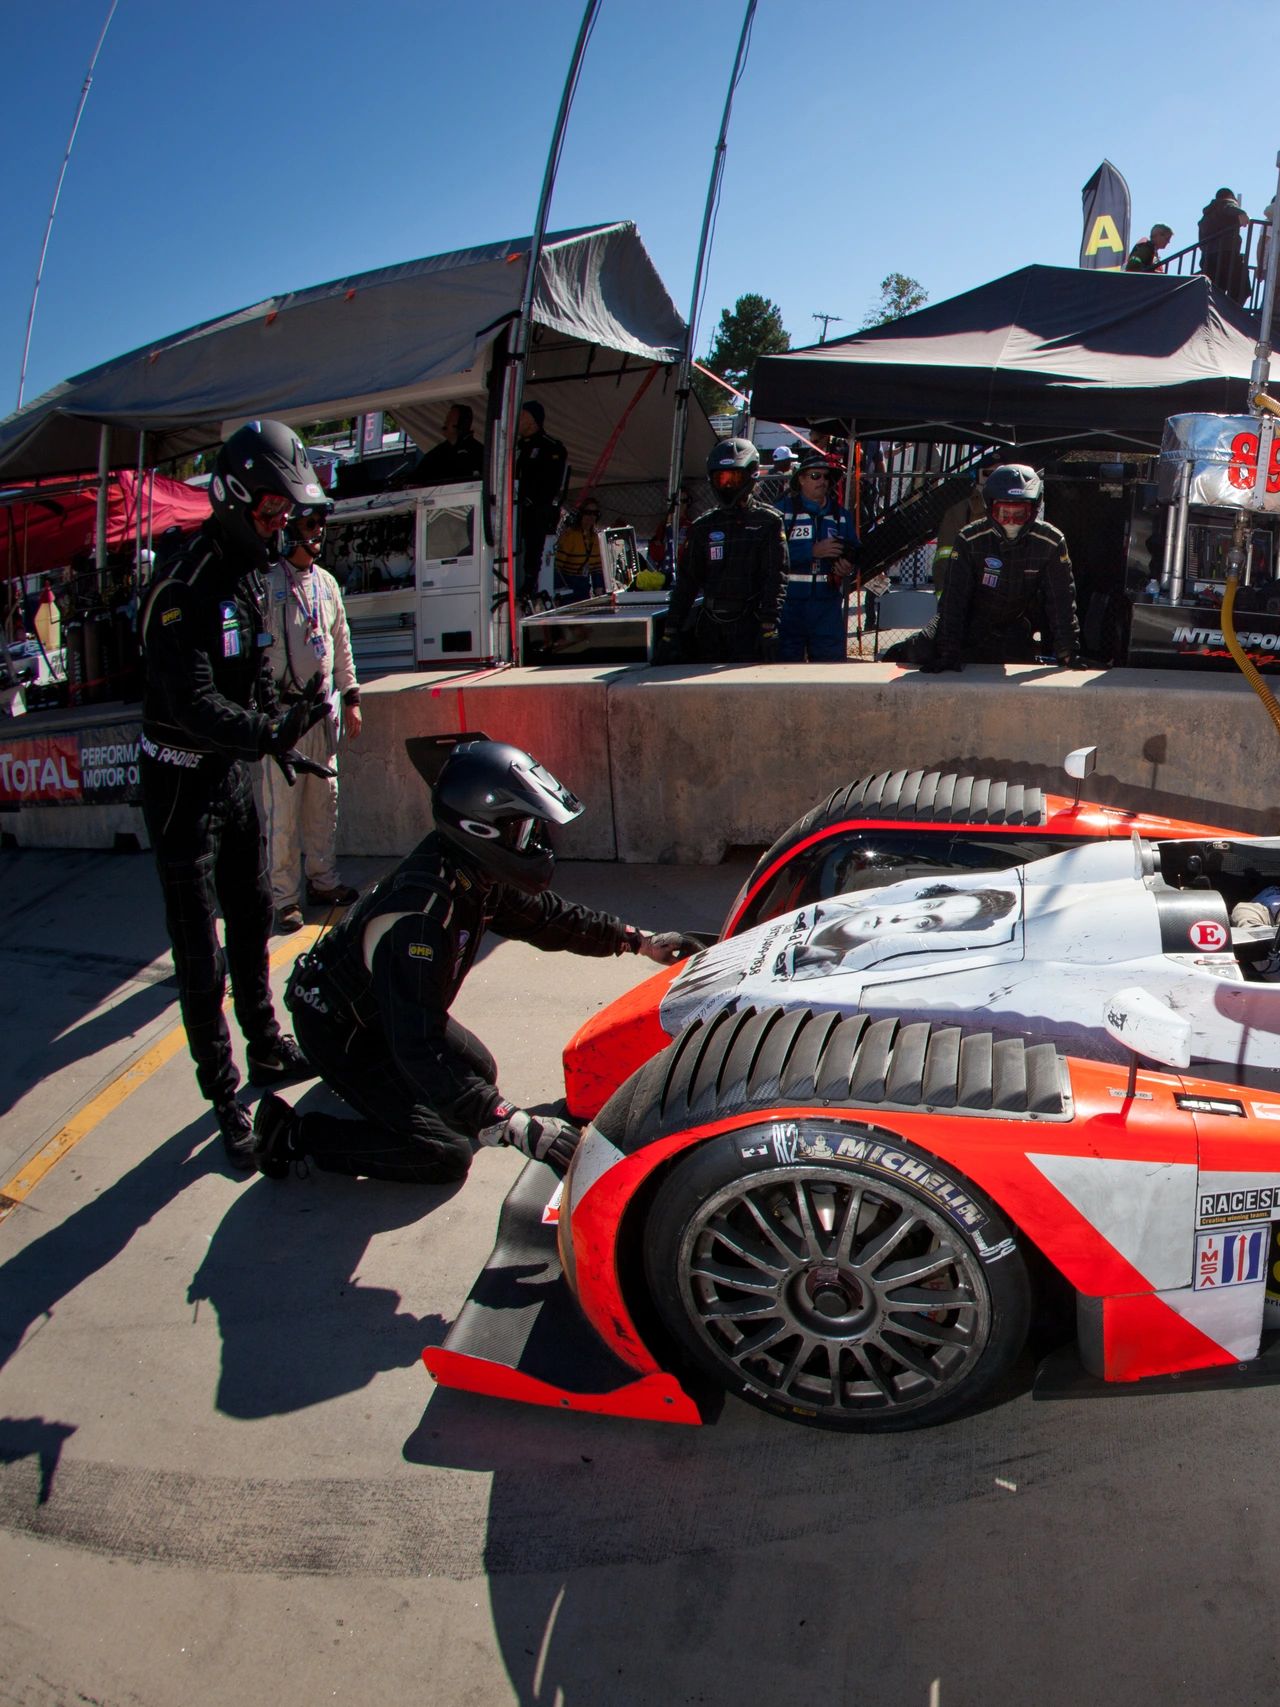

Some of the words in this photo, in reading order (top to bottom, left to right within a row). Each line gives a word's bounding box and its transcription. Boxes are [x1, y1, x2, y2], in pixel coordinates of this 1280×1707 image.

[1085, 215, 1124, 256] A
[0, 753, 79, 792] TOTAL
[83, 768, 125, 789] MOTOR
[1197, 924, 1221, 945] E
[836, 1137, 984, 1226] MICHELIN
[1202, 1215, 1226, 1225] Creating
[1226, 1213, 1249, 1223] winning
